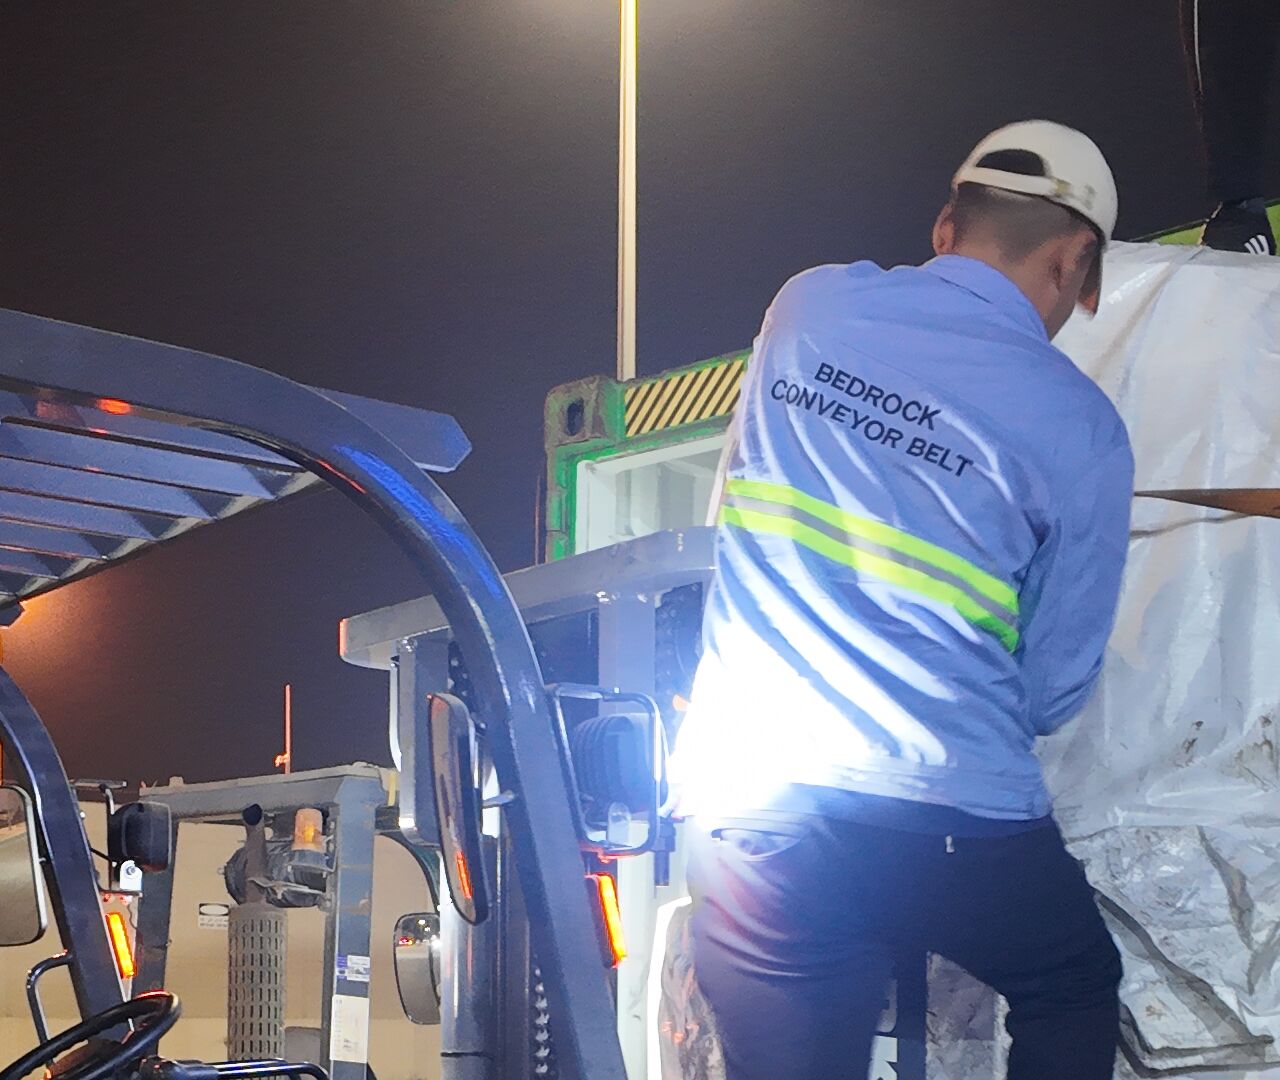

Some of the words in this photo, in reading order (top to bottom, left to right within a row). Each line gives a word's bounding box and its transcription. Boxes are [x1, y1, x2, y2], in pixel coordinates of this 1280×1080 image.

[770, 379, 904, 449] CONVEYOR
[905, 437, 975, 478] BELT
[814, 362, 942, 431] BEDROCK
